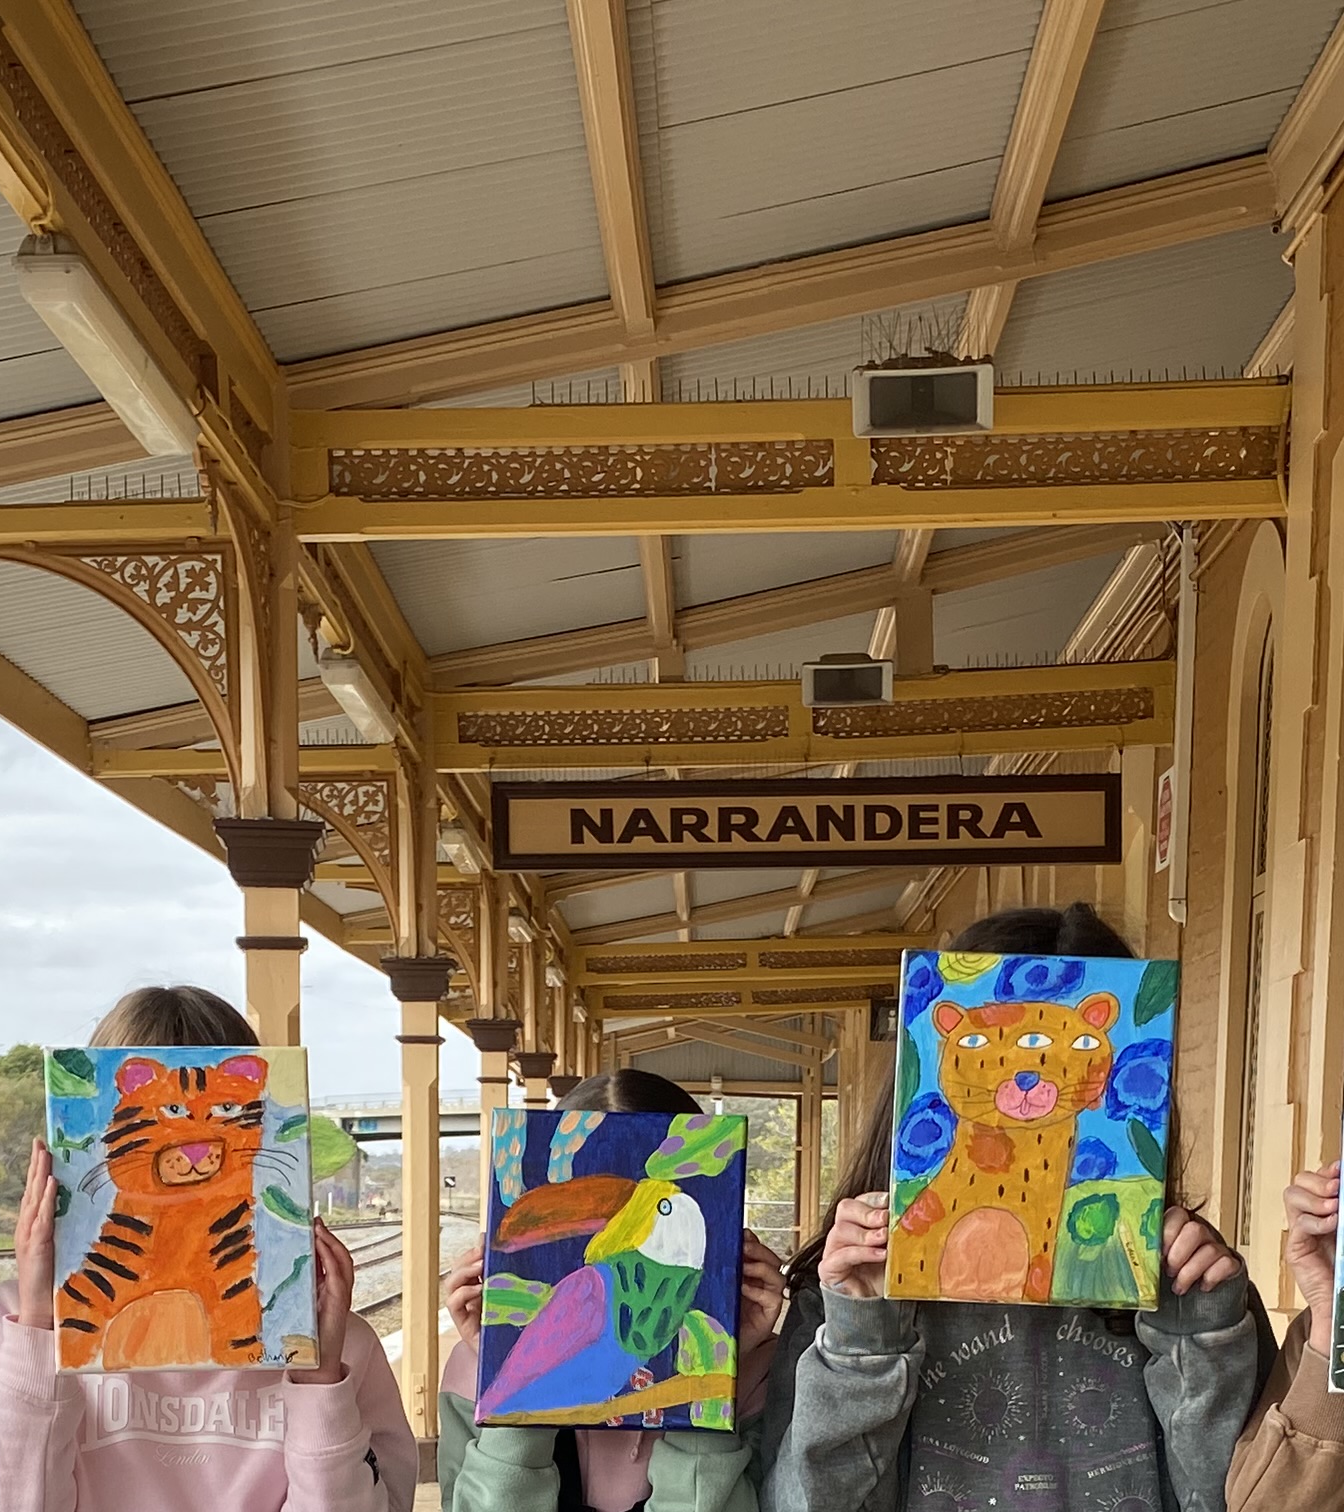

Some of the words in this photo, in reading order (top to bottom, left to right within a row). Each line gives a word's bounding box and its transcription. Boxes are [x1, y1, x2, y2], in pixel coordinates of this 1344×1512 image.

[570, 801, 1043, 845] NARRANDERA
[949, 1313, 1015, 1367] wand
[1056, 1314, 1138, 1369] chooses
[79, 1373, 287, 1450] LONSDALE
[152, 1444, 213, 1467] London
